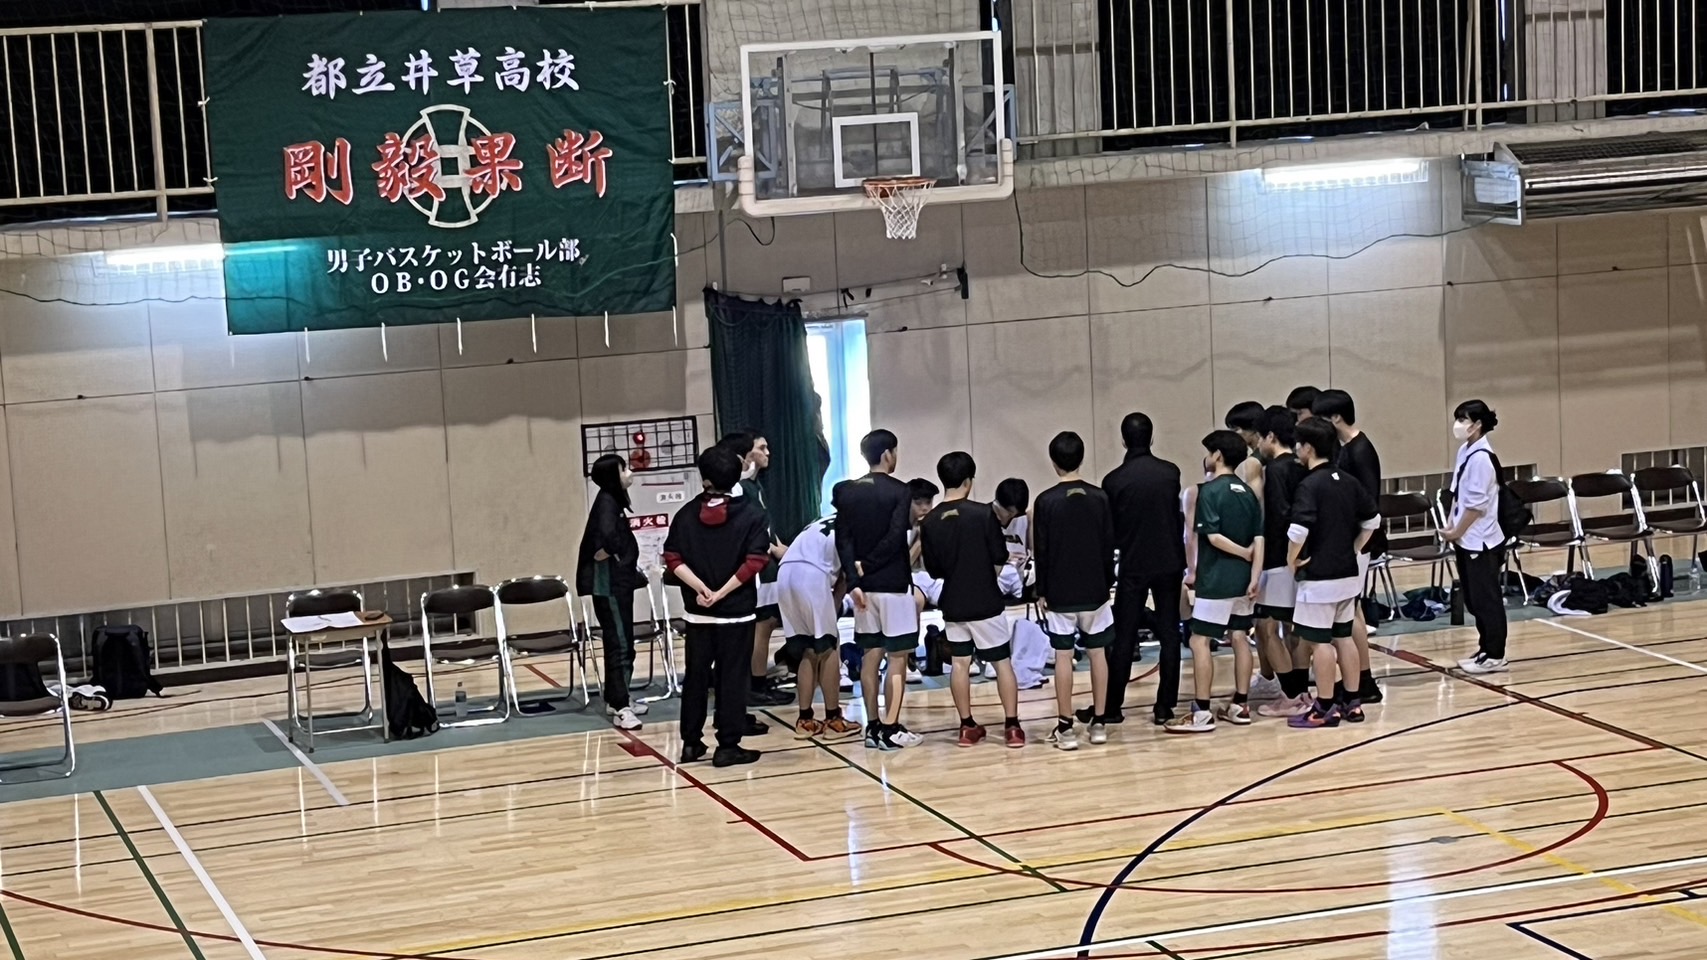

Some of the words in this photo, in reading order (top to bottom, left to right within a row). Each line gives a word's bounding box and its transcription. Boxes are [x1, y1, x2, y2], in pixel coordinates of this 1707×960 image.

[302, 47, 580, 99] 都立井草高校
[283, 128, 613, 204] 剛毅果断
[327, 238, 581, 273] 男子バスケットボール部
